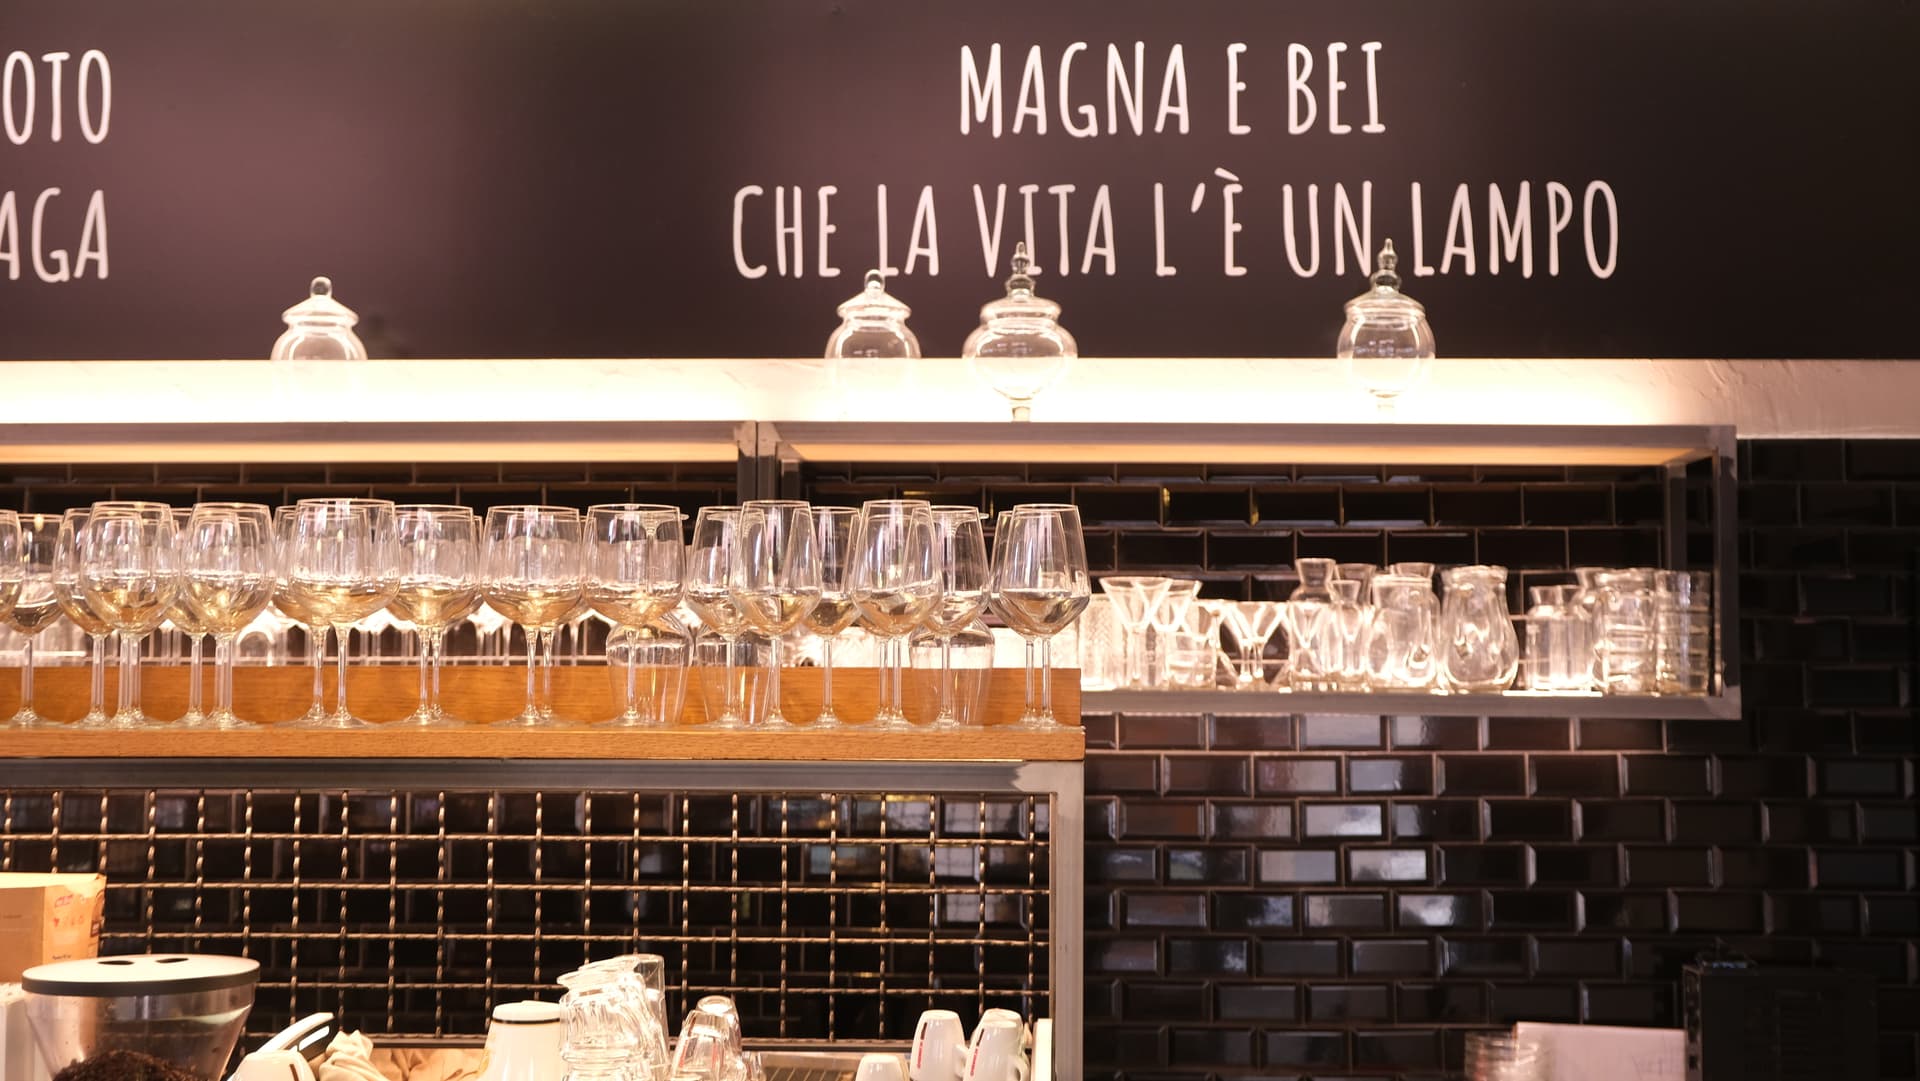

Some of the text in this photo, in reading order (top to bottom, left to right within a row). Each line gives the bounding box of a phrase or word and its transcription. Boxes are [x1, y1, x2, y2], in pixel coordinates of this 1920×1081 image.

[2, 49, 113, 145] OTO
[959, 41, 1386, 138] MAGNA E BEI
[0, 187, 109, 283] AGA
[732, 185, 841, 279] CHE
[877, 184, 940, 277] LA
[973, 183, 1116, 278] VITA
[1282, 180, 1373, 278] UN
[1411, 180, 1619, 279] LAMPO
